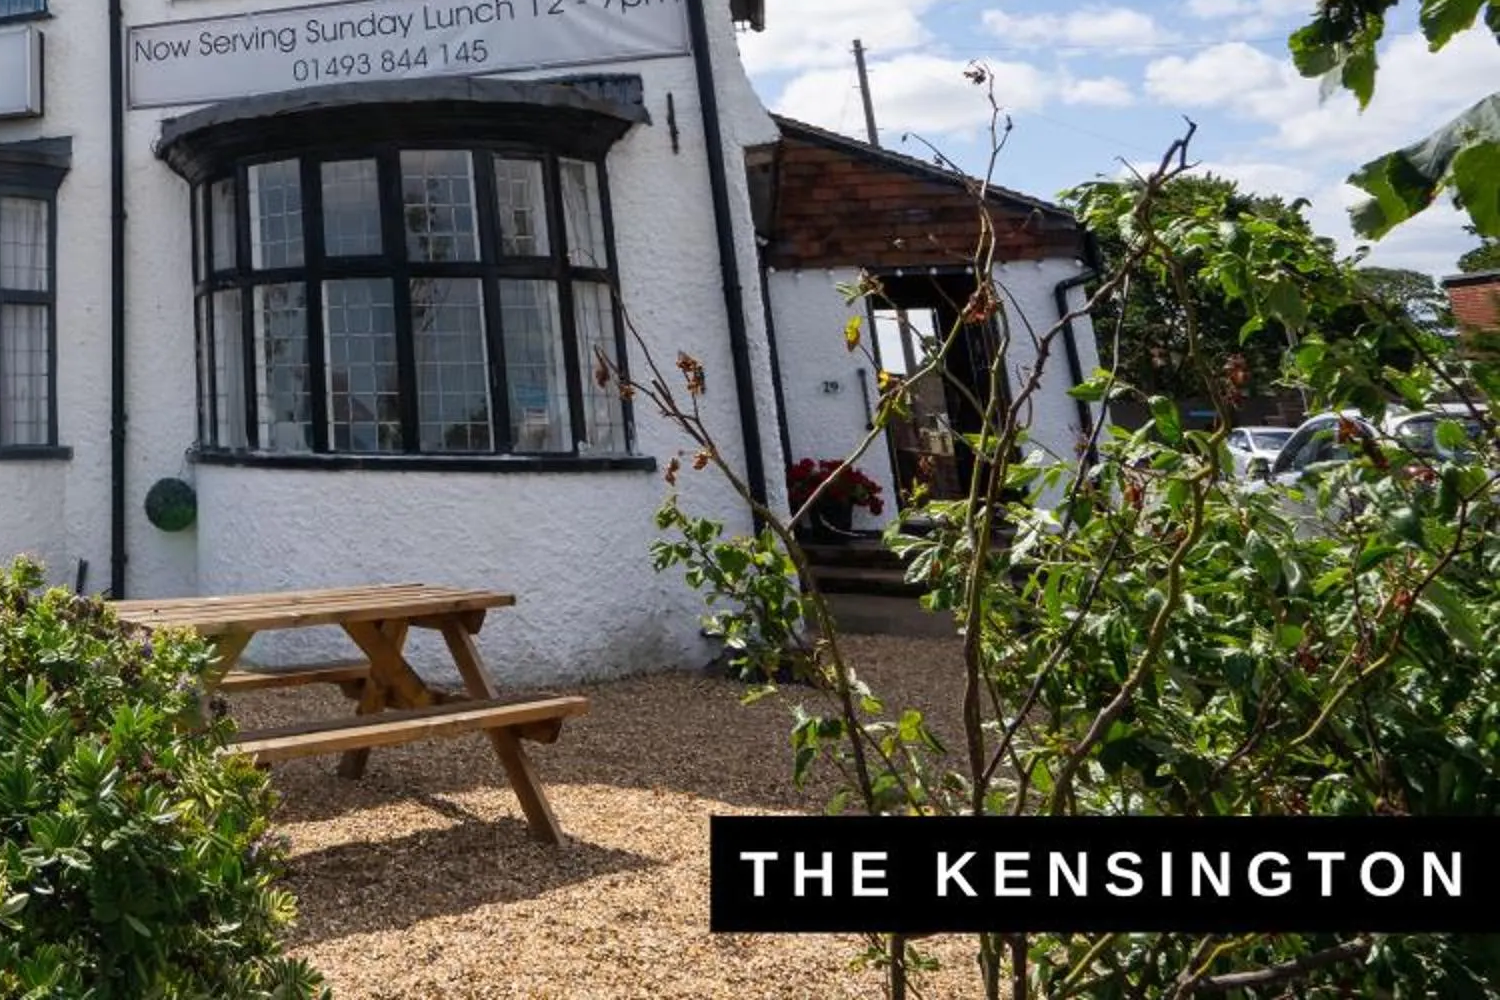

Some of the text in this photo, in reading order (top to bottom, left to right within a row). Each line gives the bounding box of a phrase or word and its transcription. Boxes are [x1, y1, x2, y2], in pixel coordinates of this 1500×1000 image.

[133, 38, 191, 63] Now
[199, 25, 297, 54] Serving
[306, 9, 414, 44] Sunday
[292, 38, 489, 82] 01493 844 145
